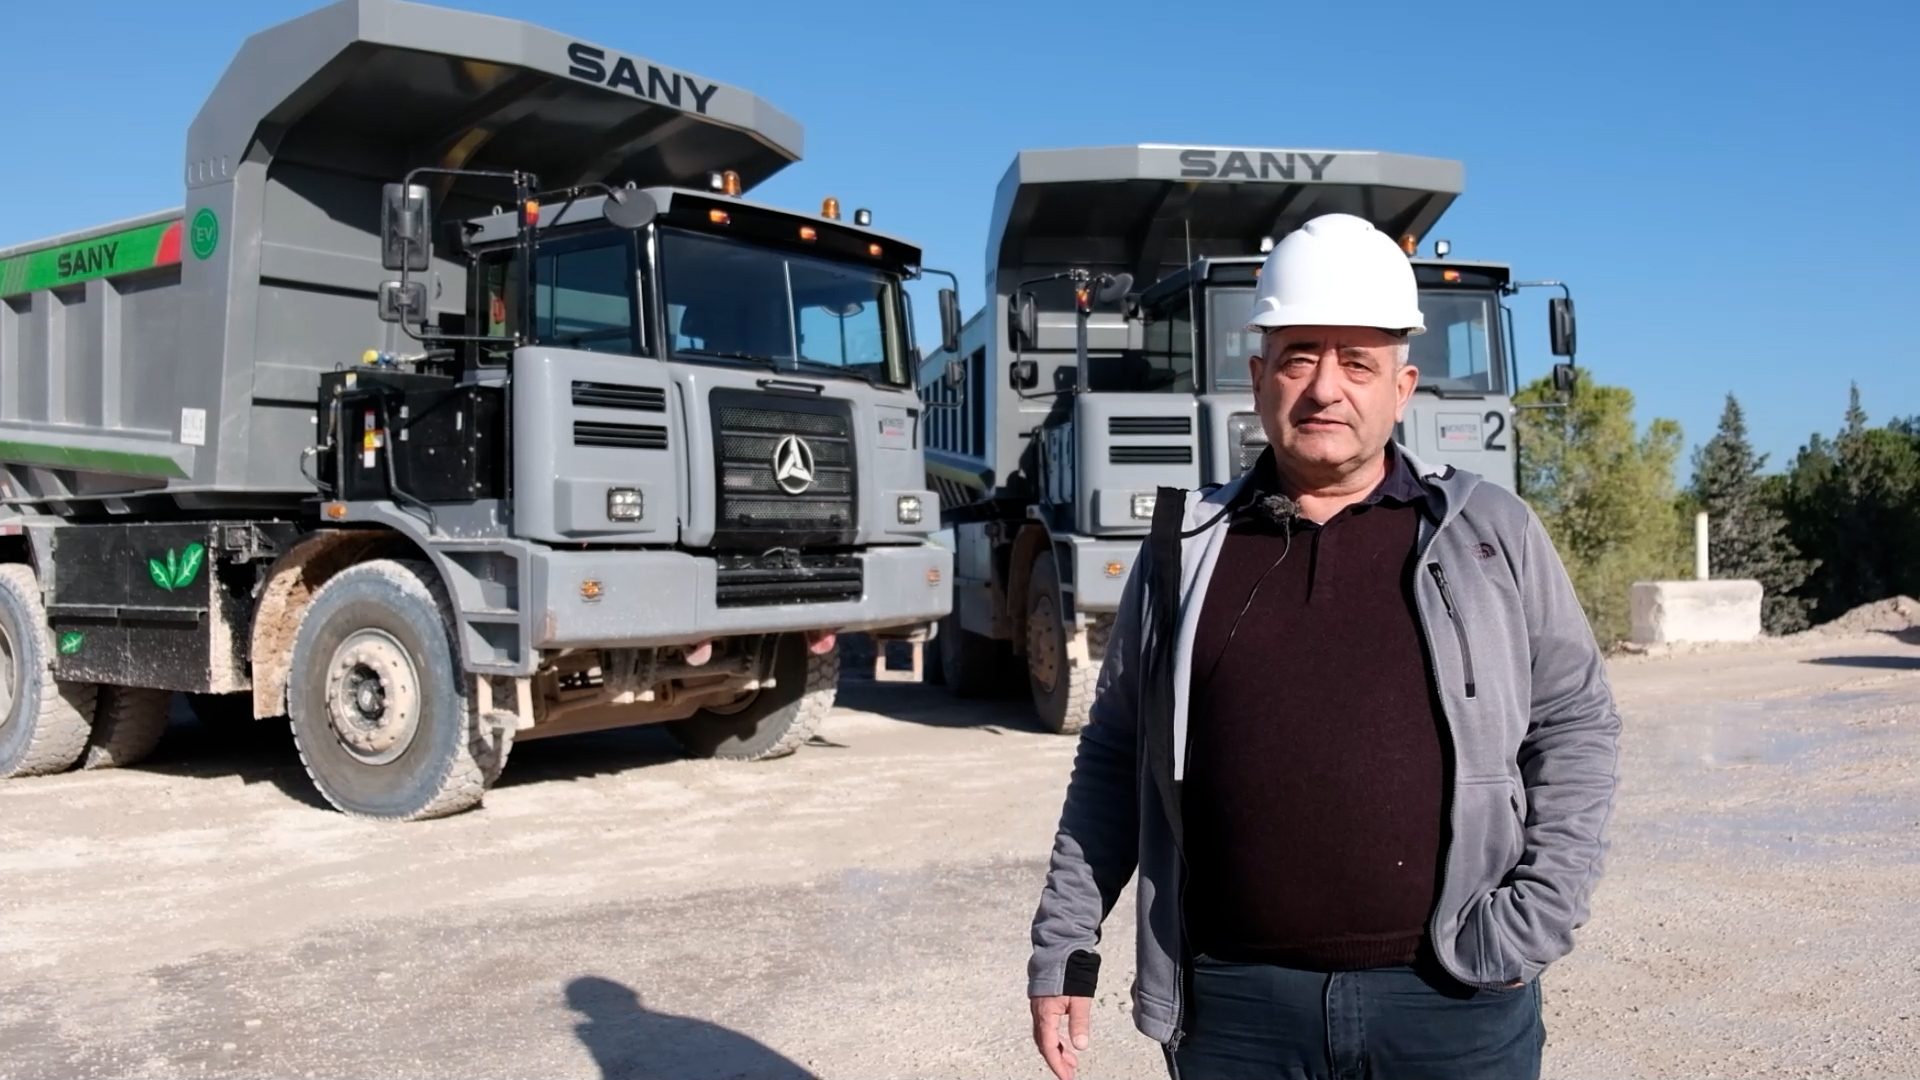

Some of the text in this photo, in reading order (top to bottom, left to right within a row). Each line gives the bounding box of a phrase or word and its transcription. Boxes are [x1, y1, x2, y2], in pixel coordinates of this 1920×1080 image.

[567, 42, 719, 115] SANY
[1179, 149, 1337, 181] SANY
[197, 226, 213, 242] EV
[58, 241, 119, 278] SANY
[1484, 410, 1506, 451] 2
